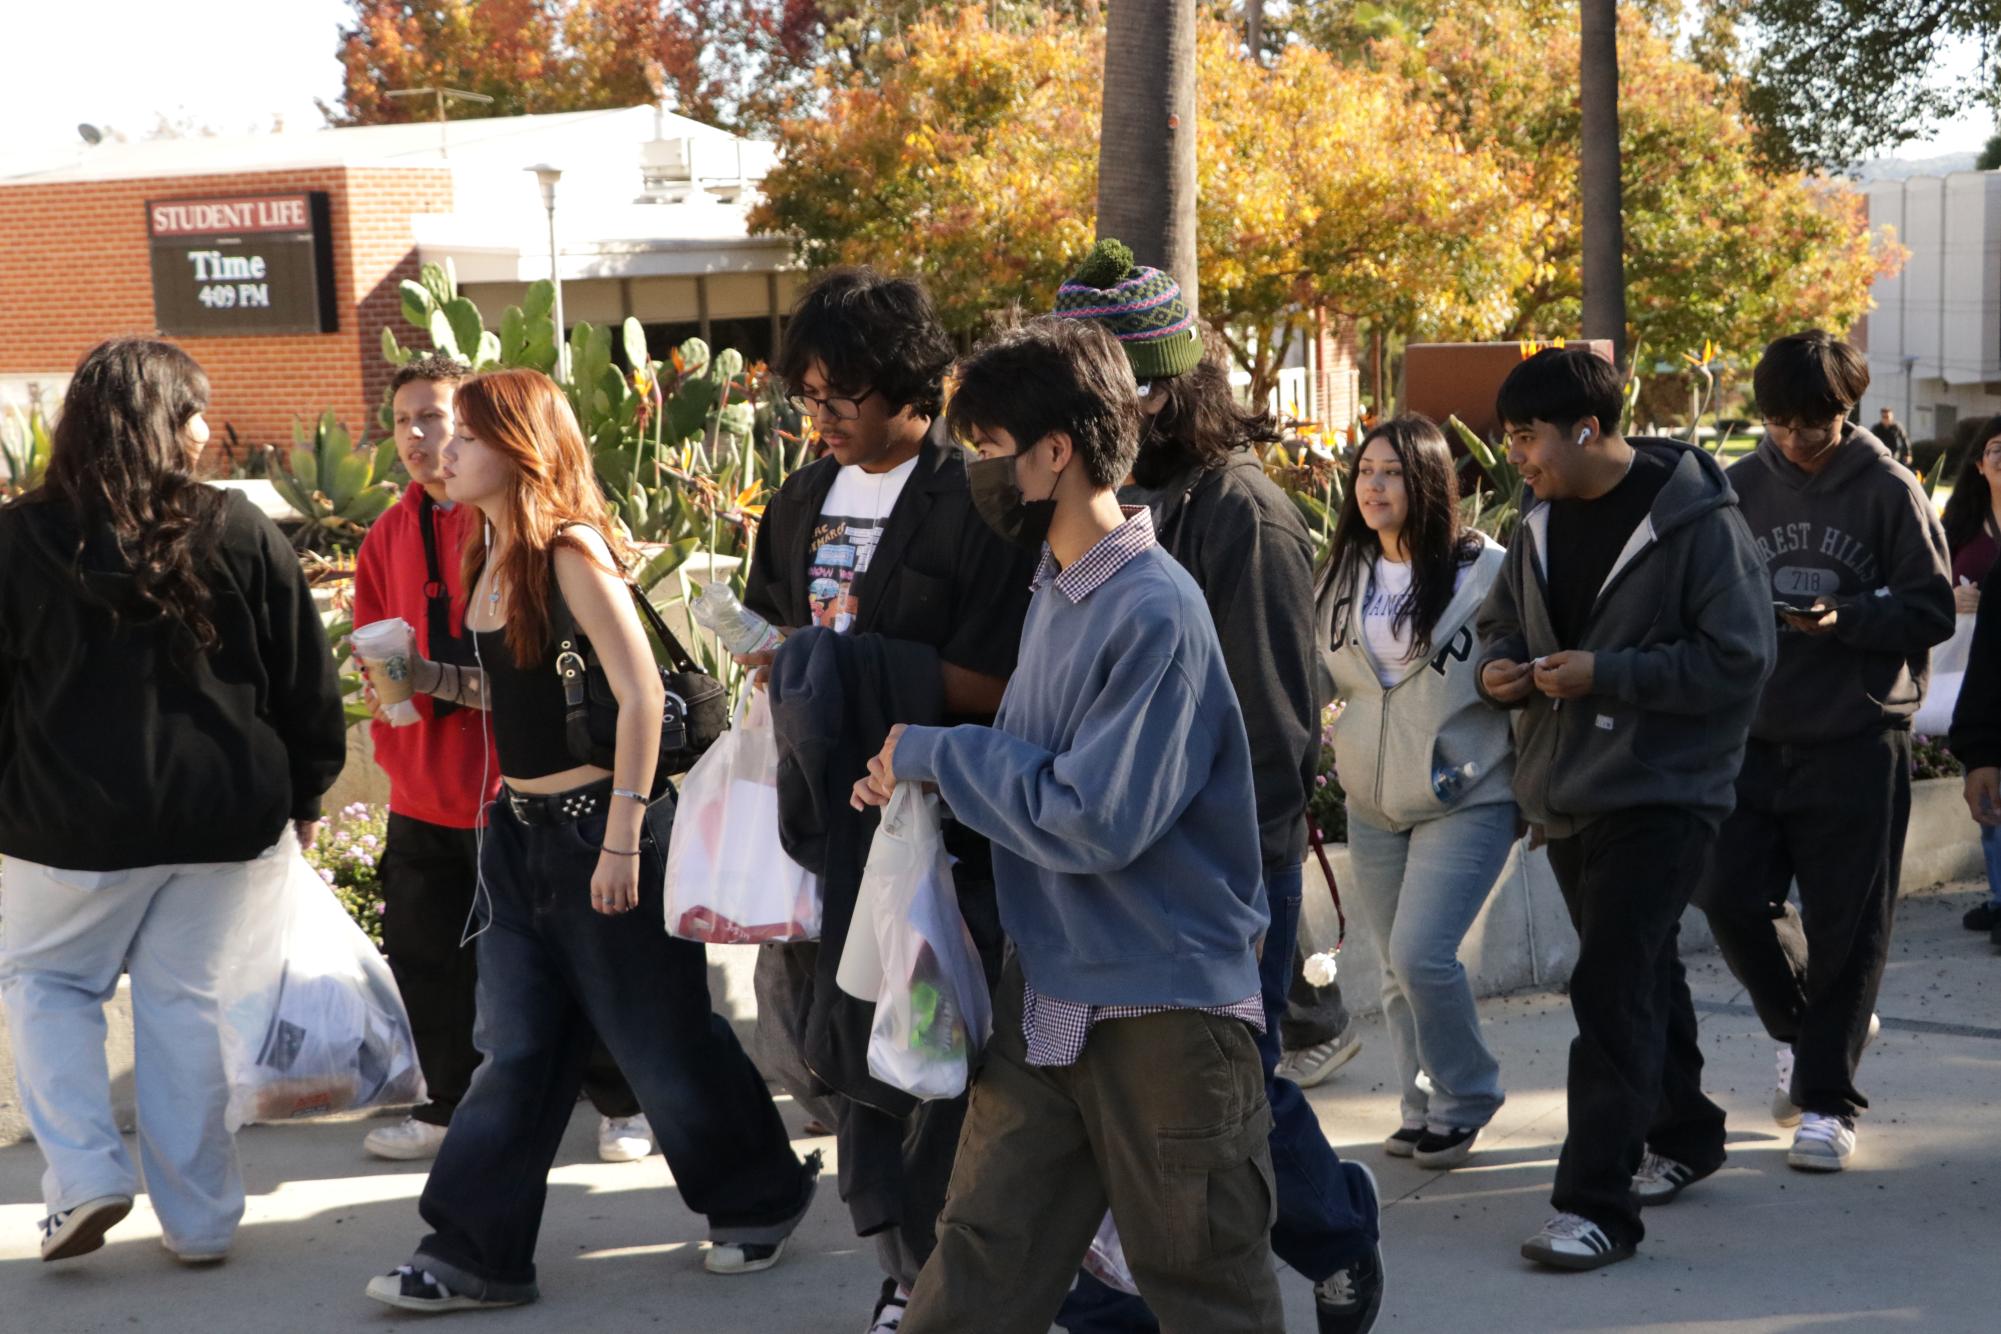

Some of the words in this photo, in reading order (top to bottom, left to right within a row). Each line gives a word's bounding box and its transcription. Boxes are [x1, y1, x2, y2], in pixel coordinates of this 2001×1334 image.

[154, 203, 254, 231] STUDENT
[258, 201, 305, 226] LIFE
[188, 251, 266, 280] Time
[238, 283, 270, 307] PM
[1756, 522, 1811, 562] REST
[1820, 526, 1879, 582] HILLS
[1791, 570, 1821, 592] 718
